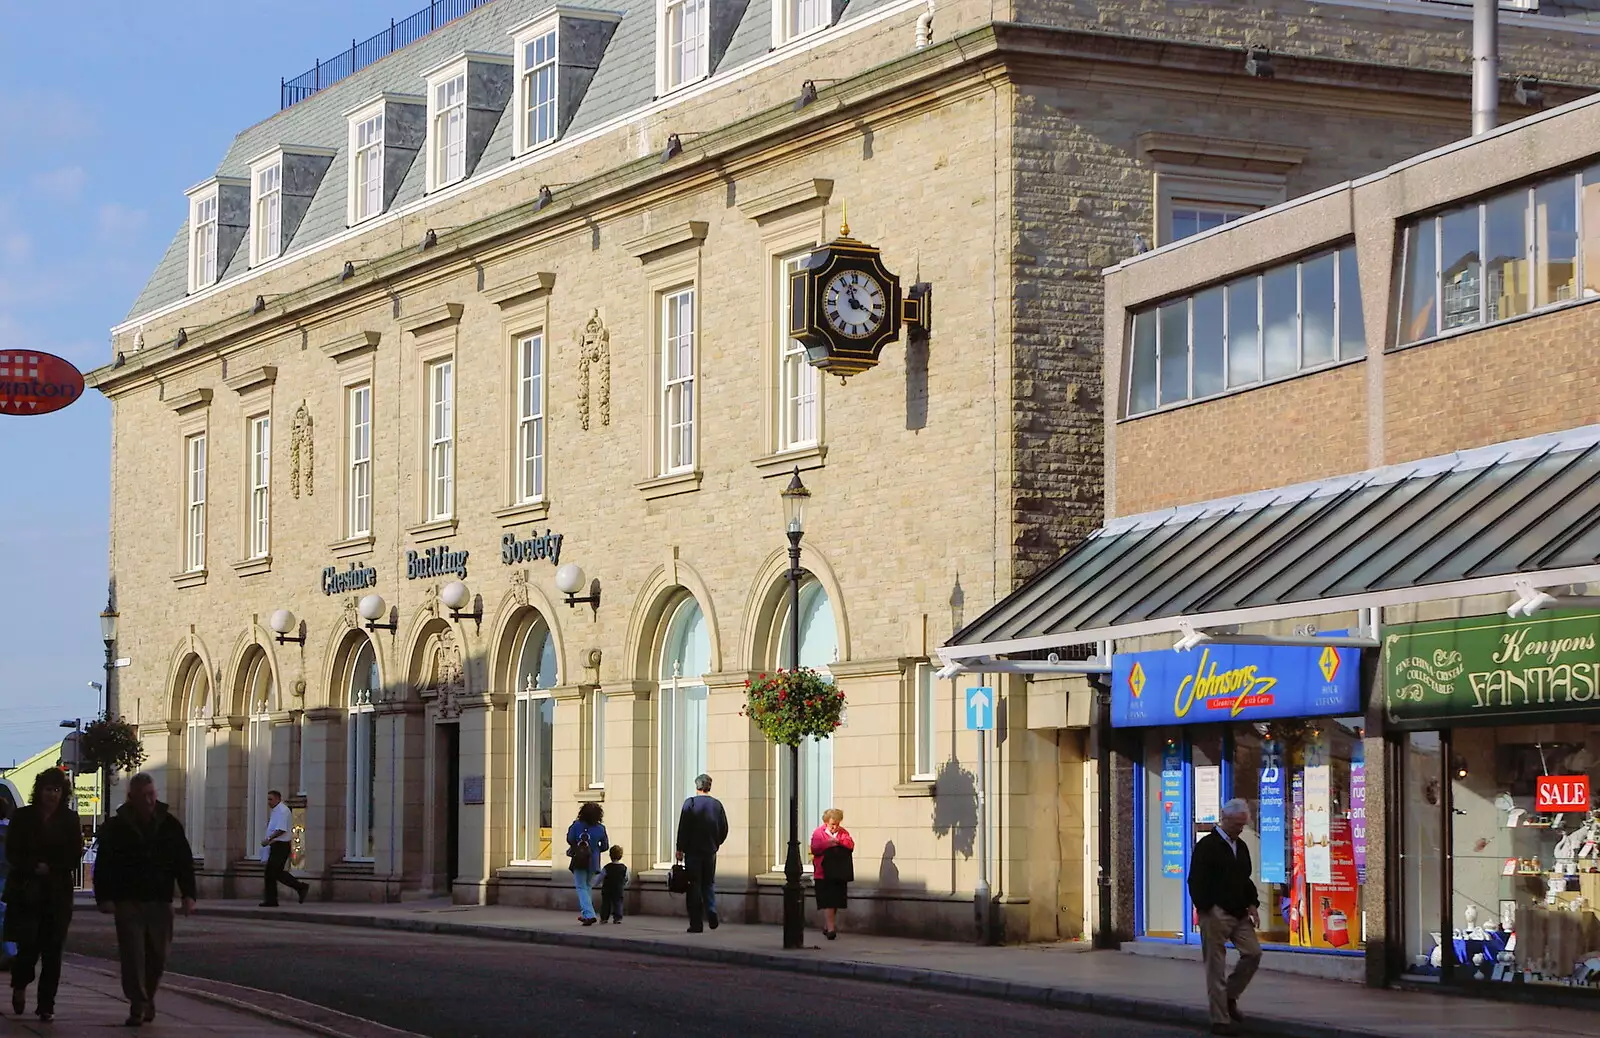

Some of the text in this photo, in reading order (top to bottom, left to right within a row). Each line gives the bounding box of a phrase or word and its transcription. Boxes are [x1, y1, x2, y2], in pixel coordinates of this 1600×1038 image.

[0, 377, 76, 397] inton
[321, 528, 564, 596] Cheshire Building Society
[1492, 627, 1596, 664] Kenyons
[1395, 657, 1411, 675] FINE
[1174, 647, 1278, 718] Johnsons
[1407, 669, 1455, 695] COLLECTABLES
[1261, 754, 1279, 783] 25
[1540, 782, 1586, 805] SALE
